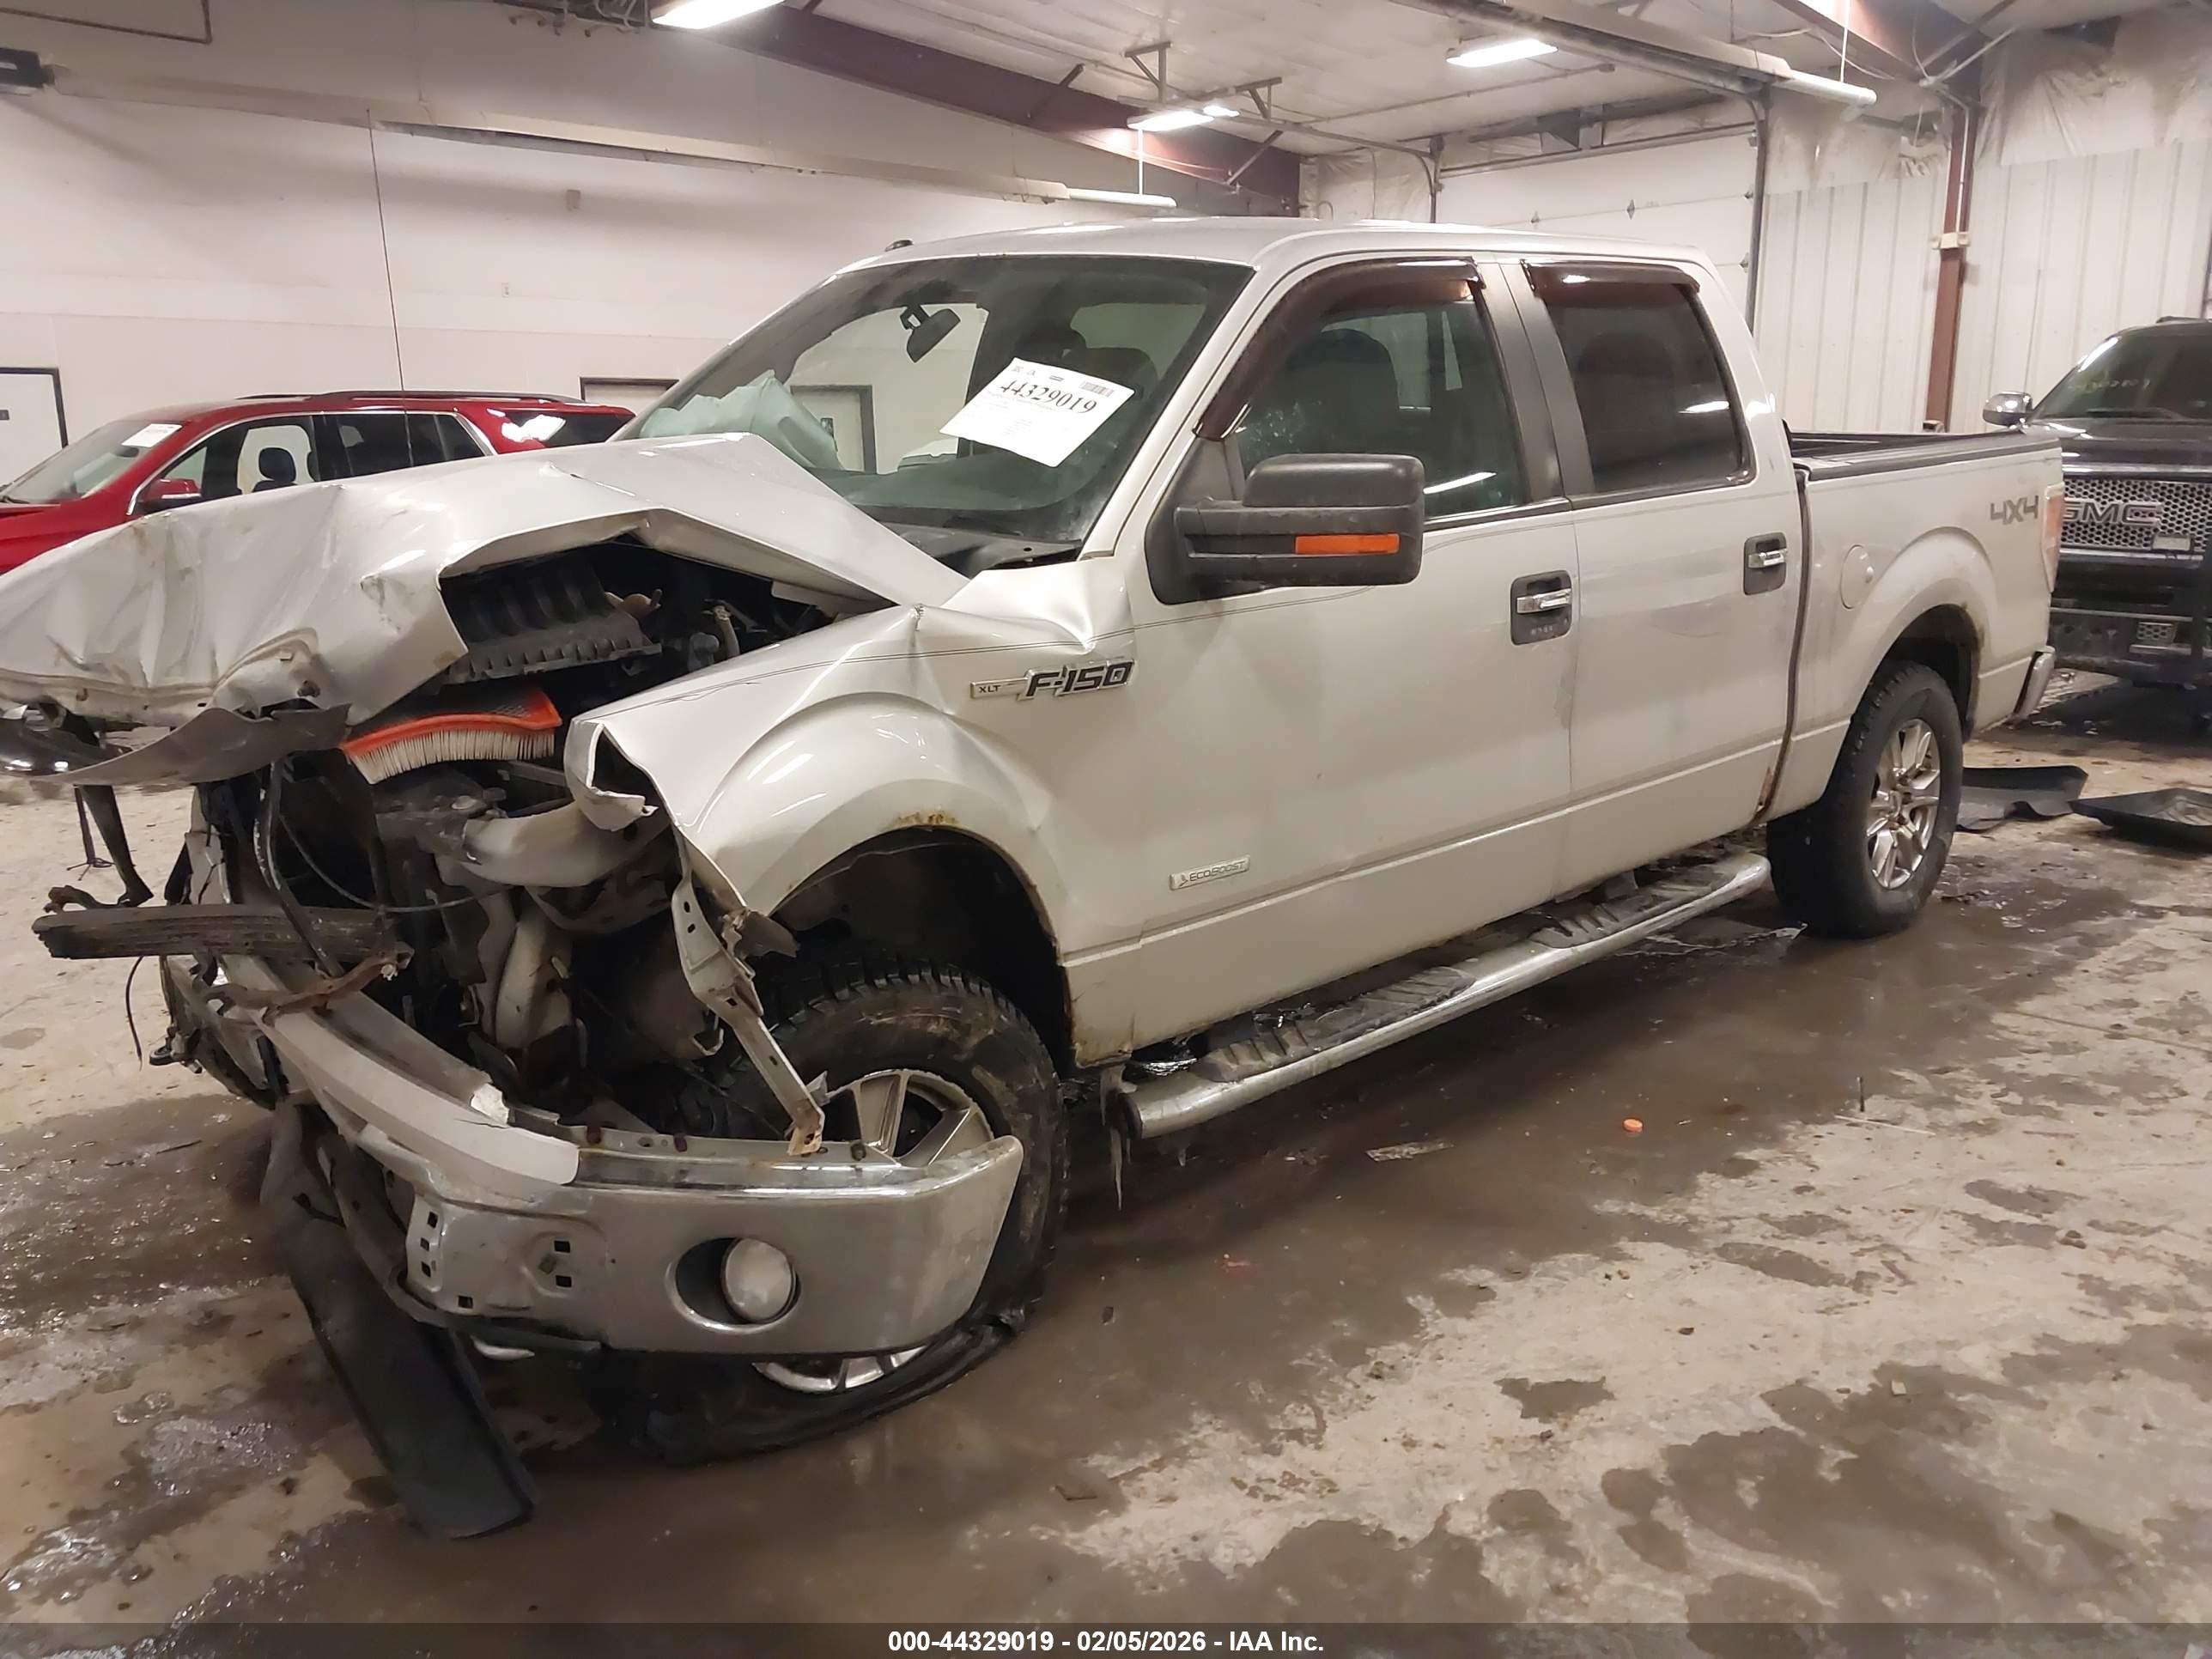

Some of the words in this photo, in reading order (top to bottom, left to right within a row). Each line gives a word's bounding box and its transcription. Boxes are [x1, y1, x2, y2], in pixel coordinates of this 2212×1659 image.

[1000, 380, 1097, 414] 44329019
[1990, 495, 2039, 525] 4X4
[978, 684, 1001, 694] XLT
[1019, 659, 1134, 699] F-150
[1188, 860, 1245, 882] ECOBOOST
